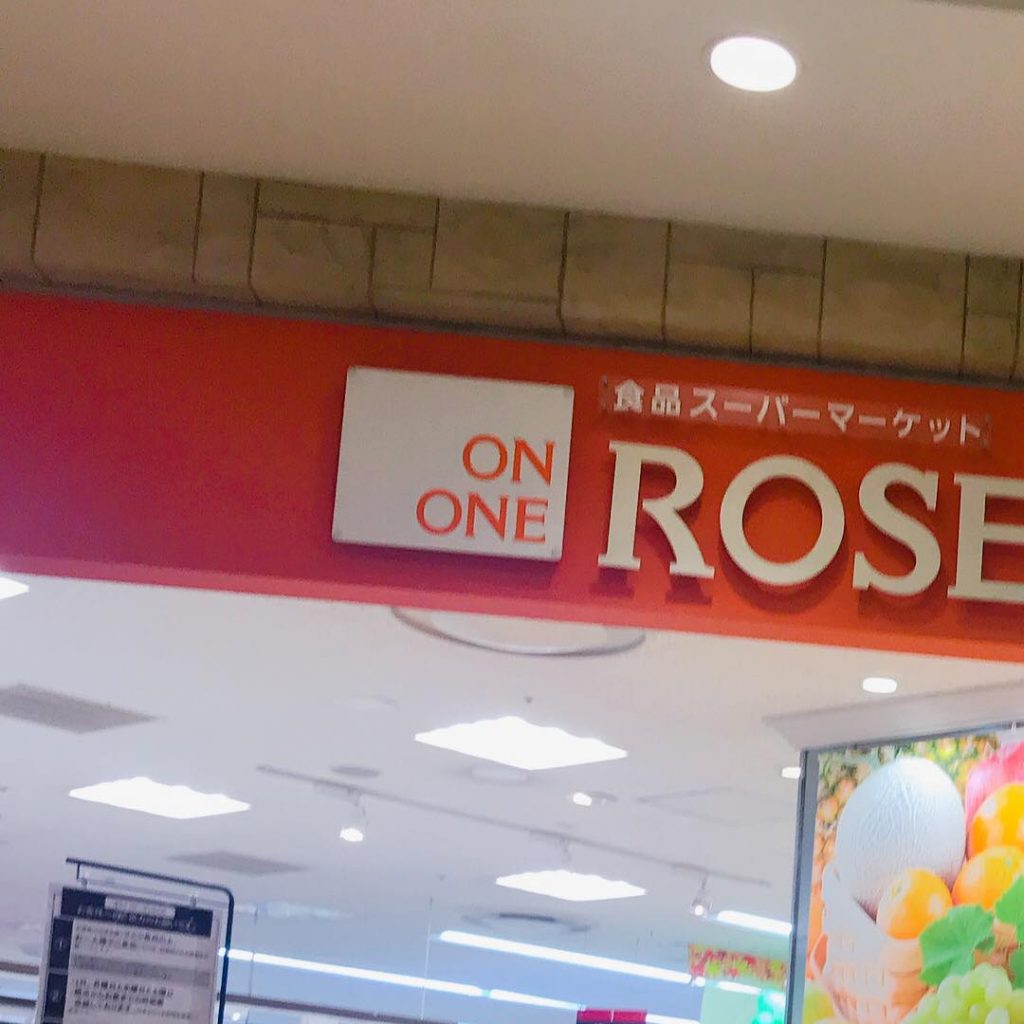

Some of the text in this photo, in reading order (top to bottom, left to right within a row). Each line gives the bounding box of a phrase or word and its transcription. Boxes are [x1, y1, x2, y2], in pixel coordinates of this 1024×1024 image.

[613, 378, 983, 448] 食品スーパーマーケット
[461, 433, 555, 485] ON
[415, 488, 549, 544] ONE
